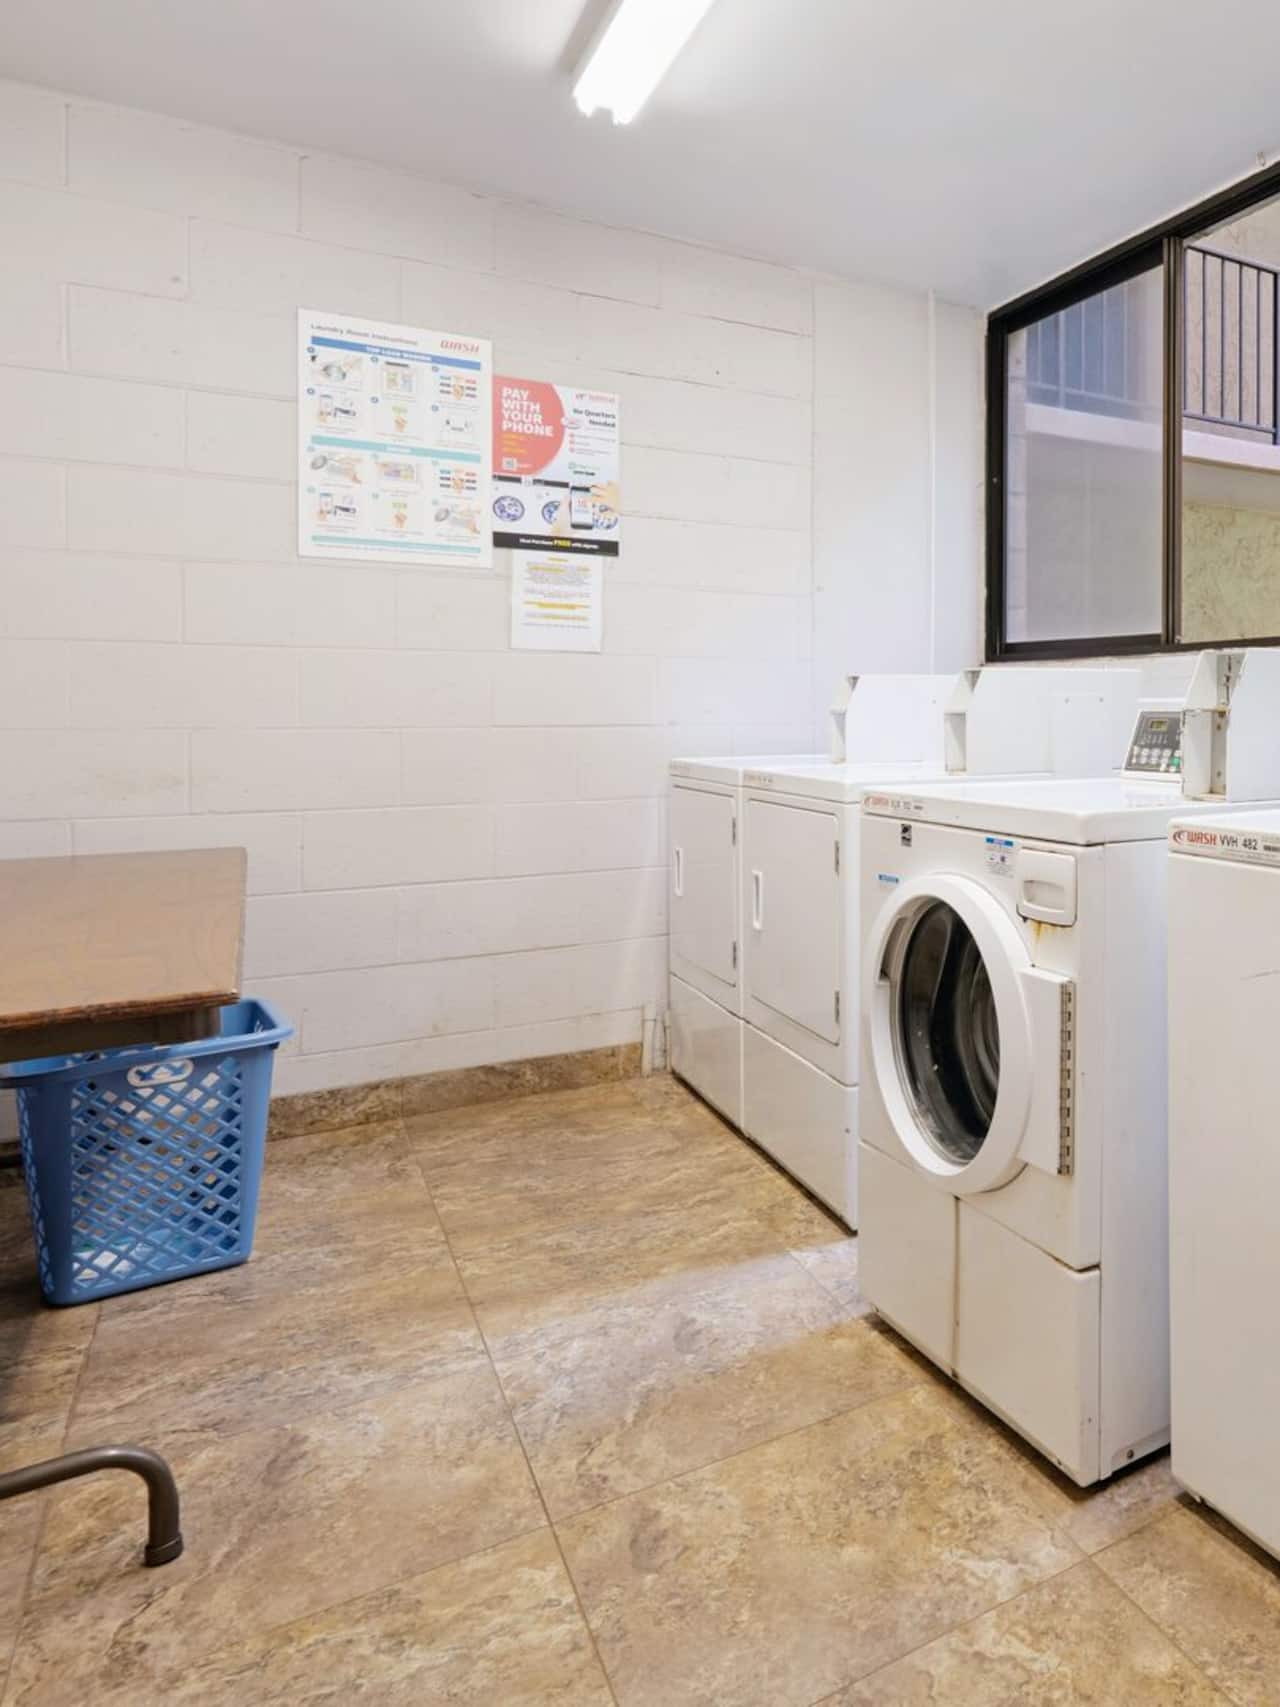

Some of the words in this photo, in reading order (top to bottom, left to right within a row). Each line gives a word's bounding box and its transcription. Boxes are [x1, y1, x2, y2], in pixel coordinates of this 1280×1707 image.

[502, 386, 529, 399] PAY
[502, 398, 541, 411] WITH
[502, 409, 543, 424] YOUR
[502, 420, 554, 437] PHONE
[1187, 831, 1217, 846] WASH
